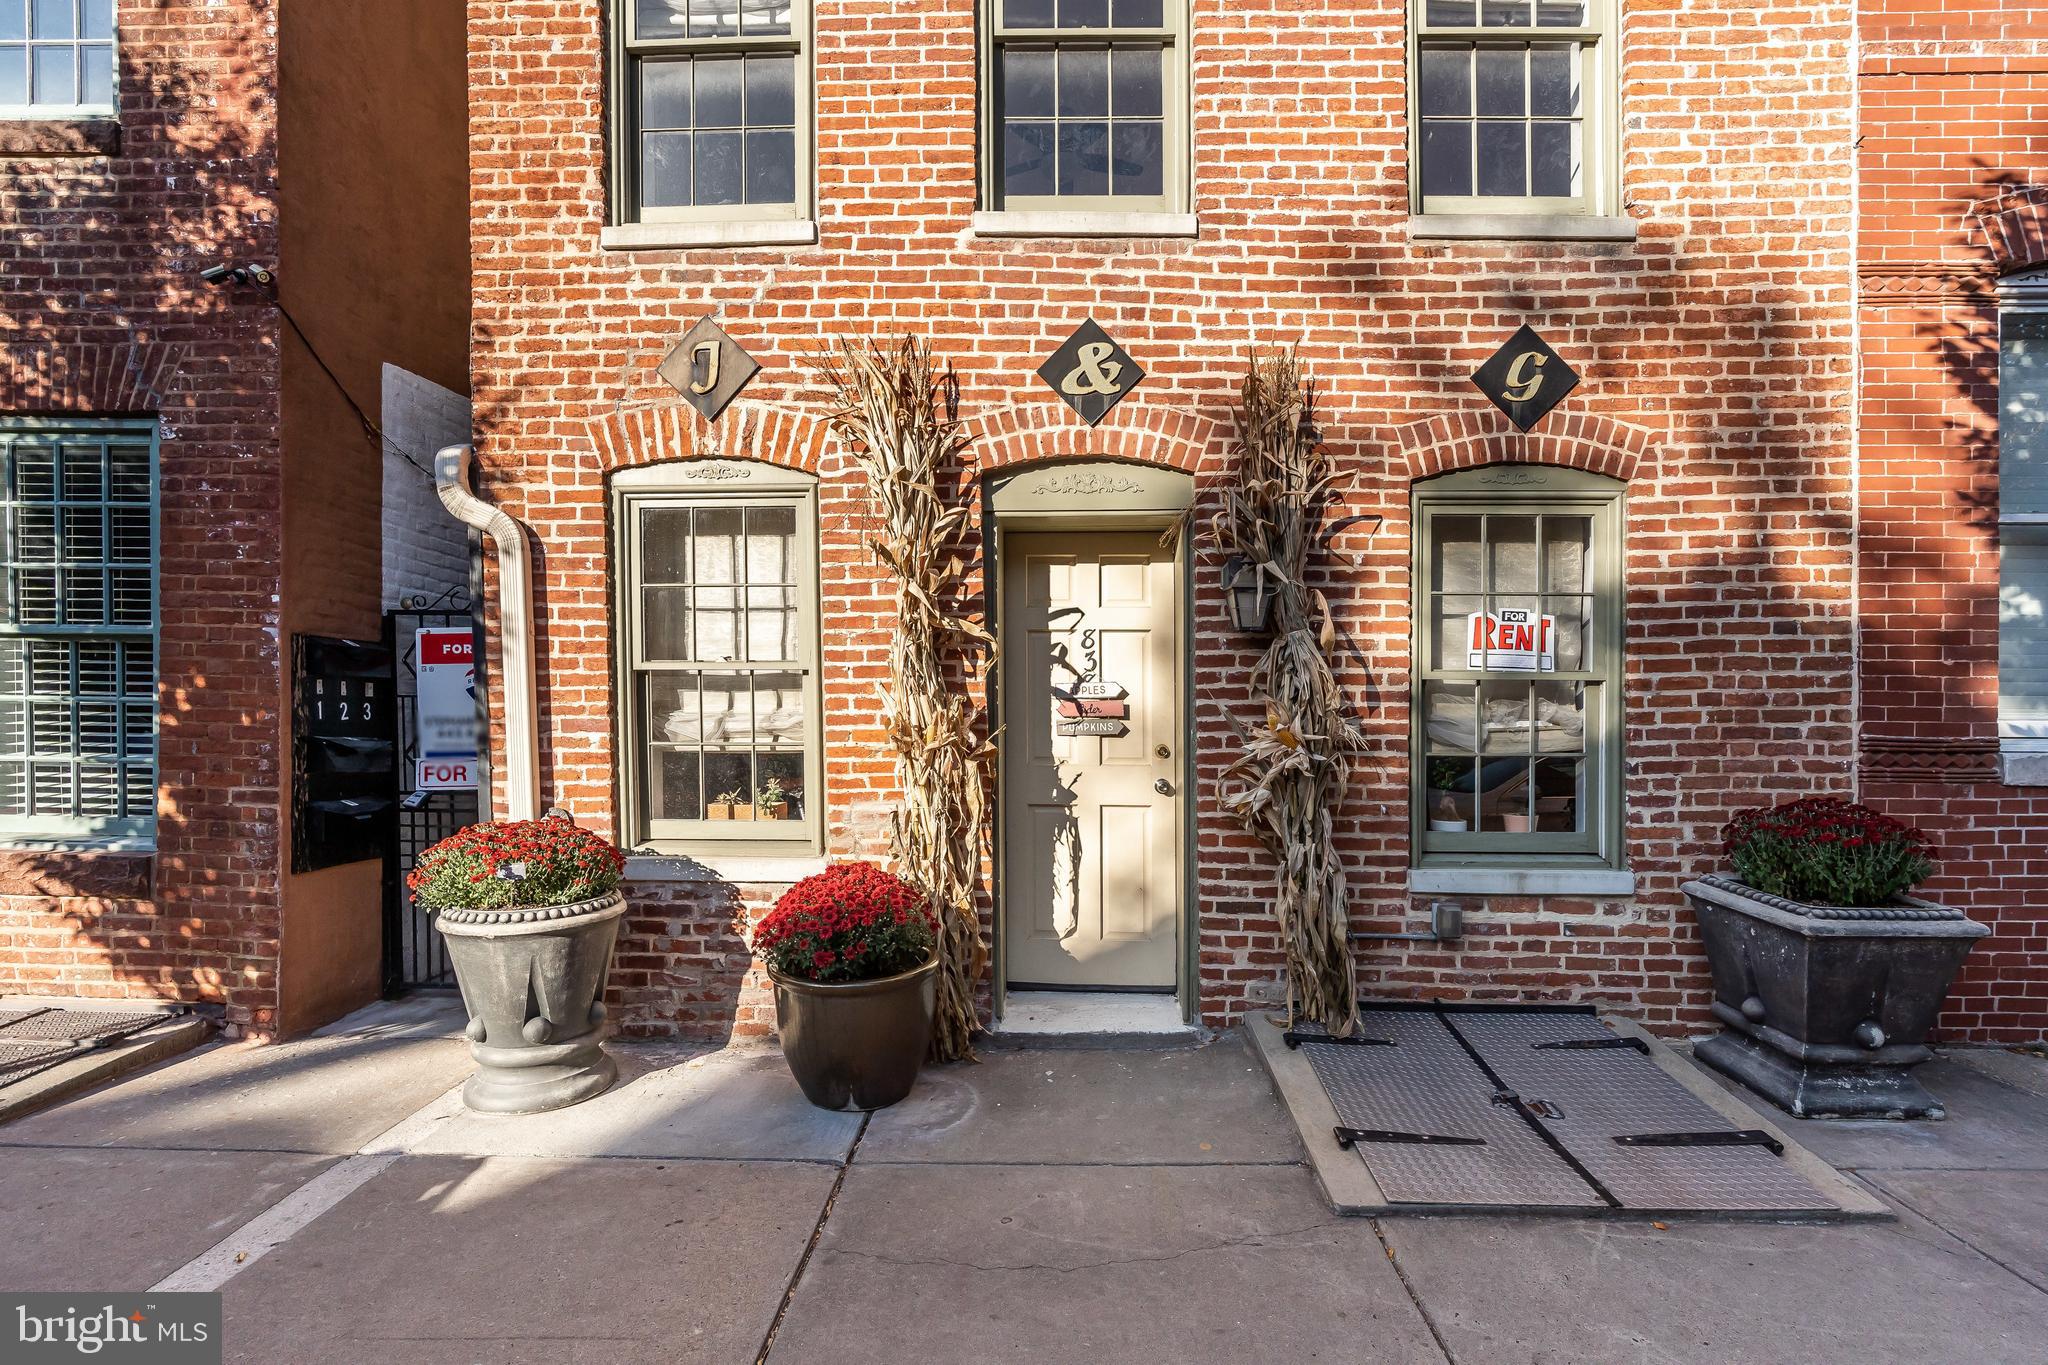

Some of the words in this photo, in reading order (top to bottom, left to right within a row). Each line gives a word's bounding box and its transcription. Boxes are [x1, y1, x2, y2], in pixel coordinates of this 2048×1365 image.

[690, 340, 722, 395] J
[1061, 342, 1123, 395] &
[1502, 351, 1548, 402] G
[1504, 612, 1525, 622] FOR
[1472, 616, 1551, 653] RENT
[442, 644, 472, 654] FOR
[1070, 685, 1106, 695] PPLES
[317, 700, 323, 720] 1
[339, 701, 350, 721] 2
[363, 702, 372, 721] 3
[1062, 722, 1114, 731] PUMPKINS
[424, 765, 467, 782] FOR
